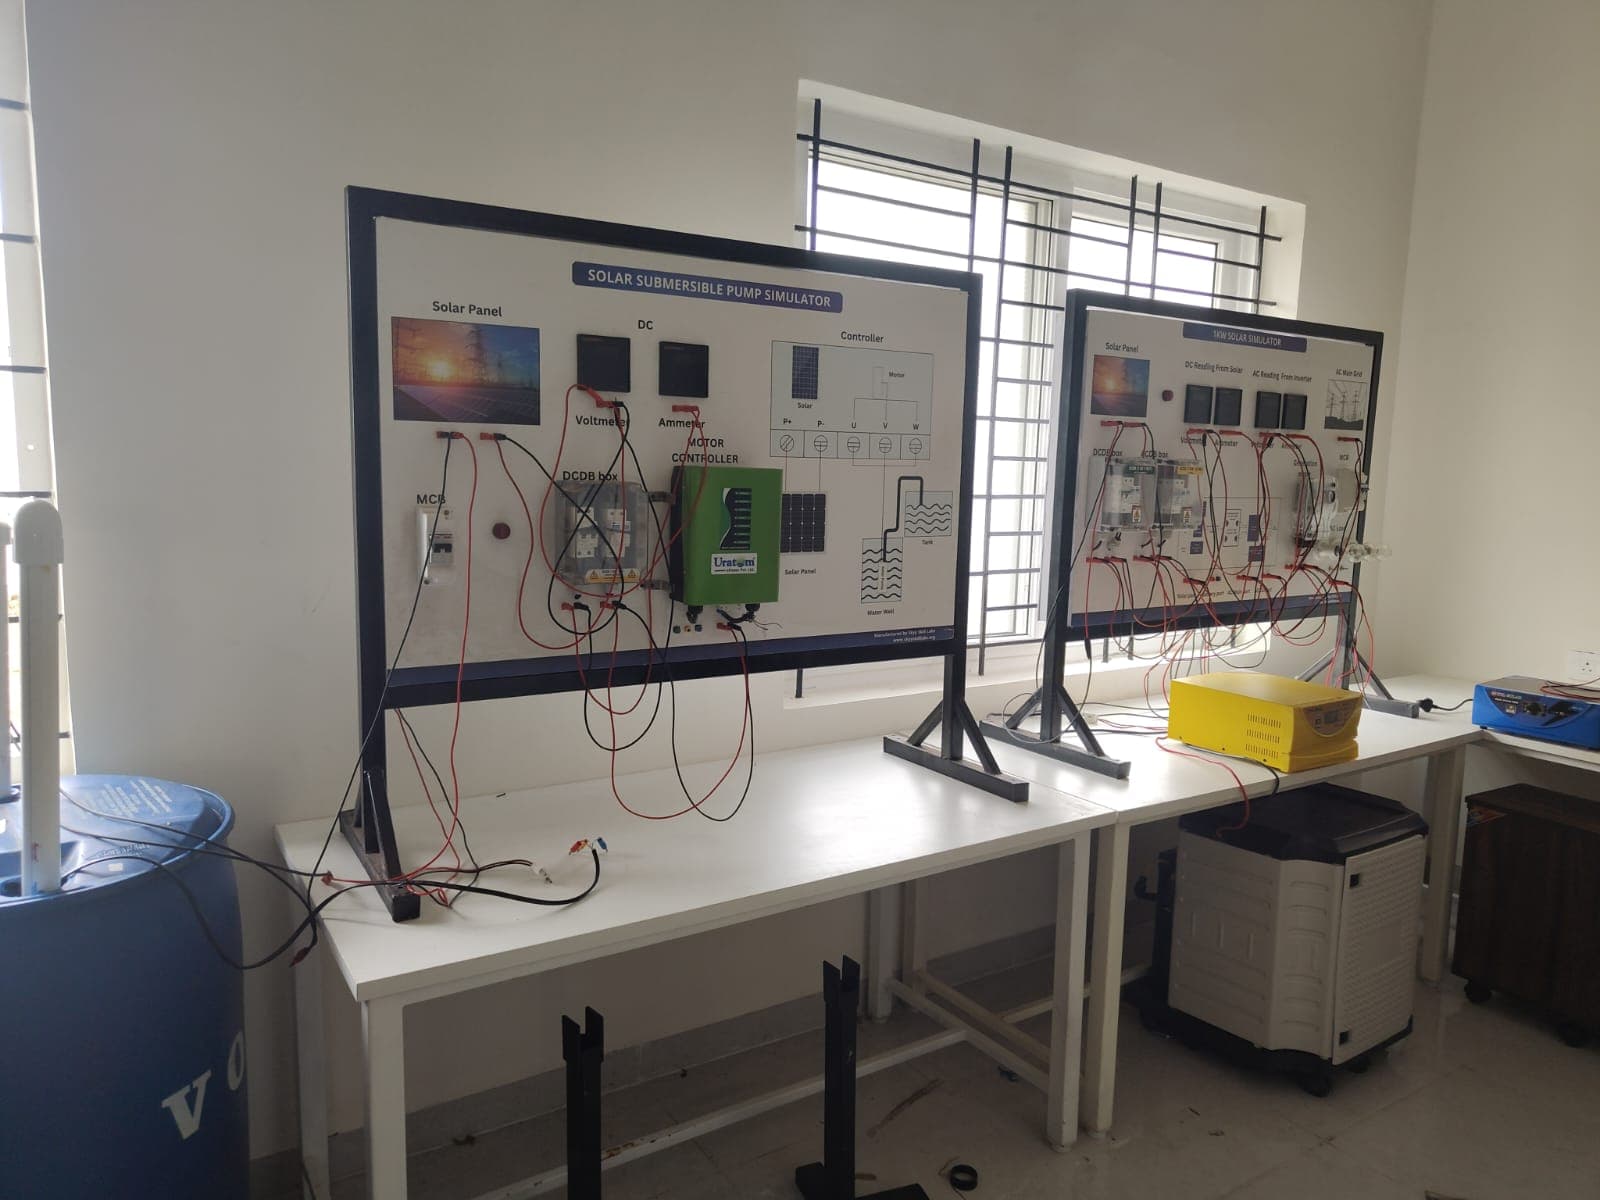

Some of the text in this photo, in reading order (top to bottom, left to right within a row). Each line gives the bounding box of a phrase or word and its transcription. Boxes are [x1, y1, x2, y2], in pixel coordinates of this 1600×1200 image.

[587, 269, 831, 308] SOLAR SUBMERSIBLE PUMP SIMULATOR
[432, 300, 503, 317] Solar Panel
[637, 319, 654, 331] DC
[840, 331, 884, 343] Controller
[1227, 331, 1248, 342] SOLAR
[1248, 333, 1282, 346] SIMULATOR
[1105, 342, 1139, 353] Solar Panel
[782, 417, 793, 425] P+
[912, 423, 920, 431] W
[688, 437, 724, 448] MOTOR
[671, 452, 739, 464] CONTROLLER
[562, 470, 618, 481] DCDB box
